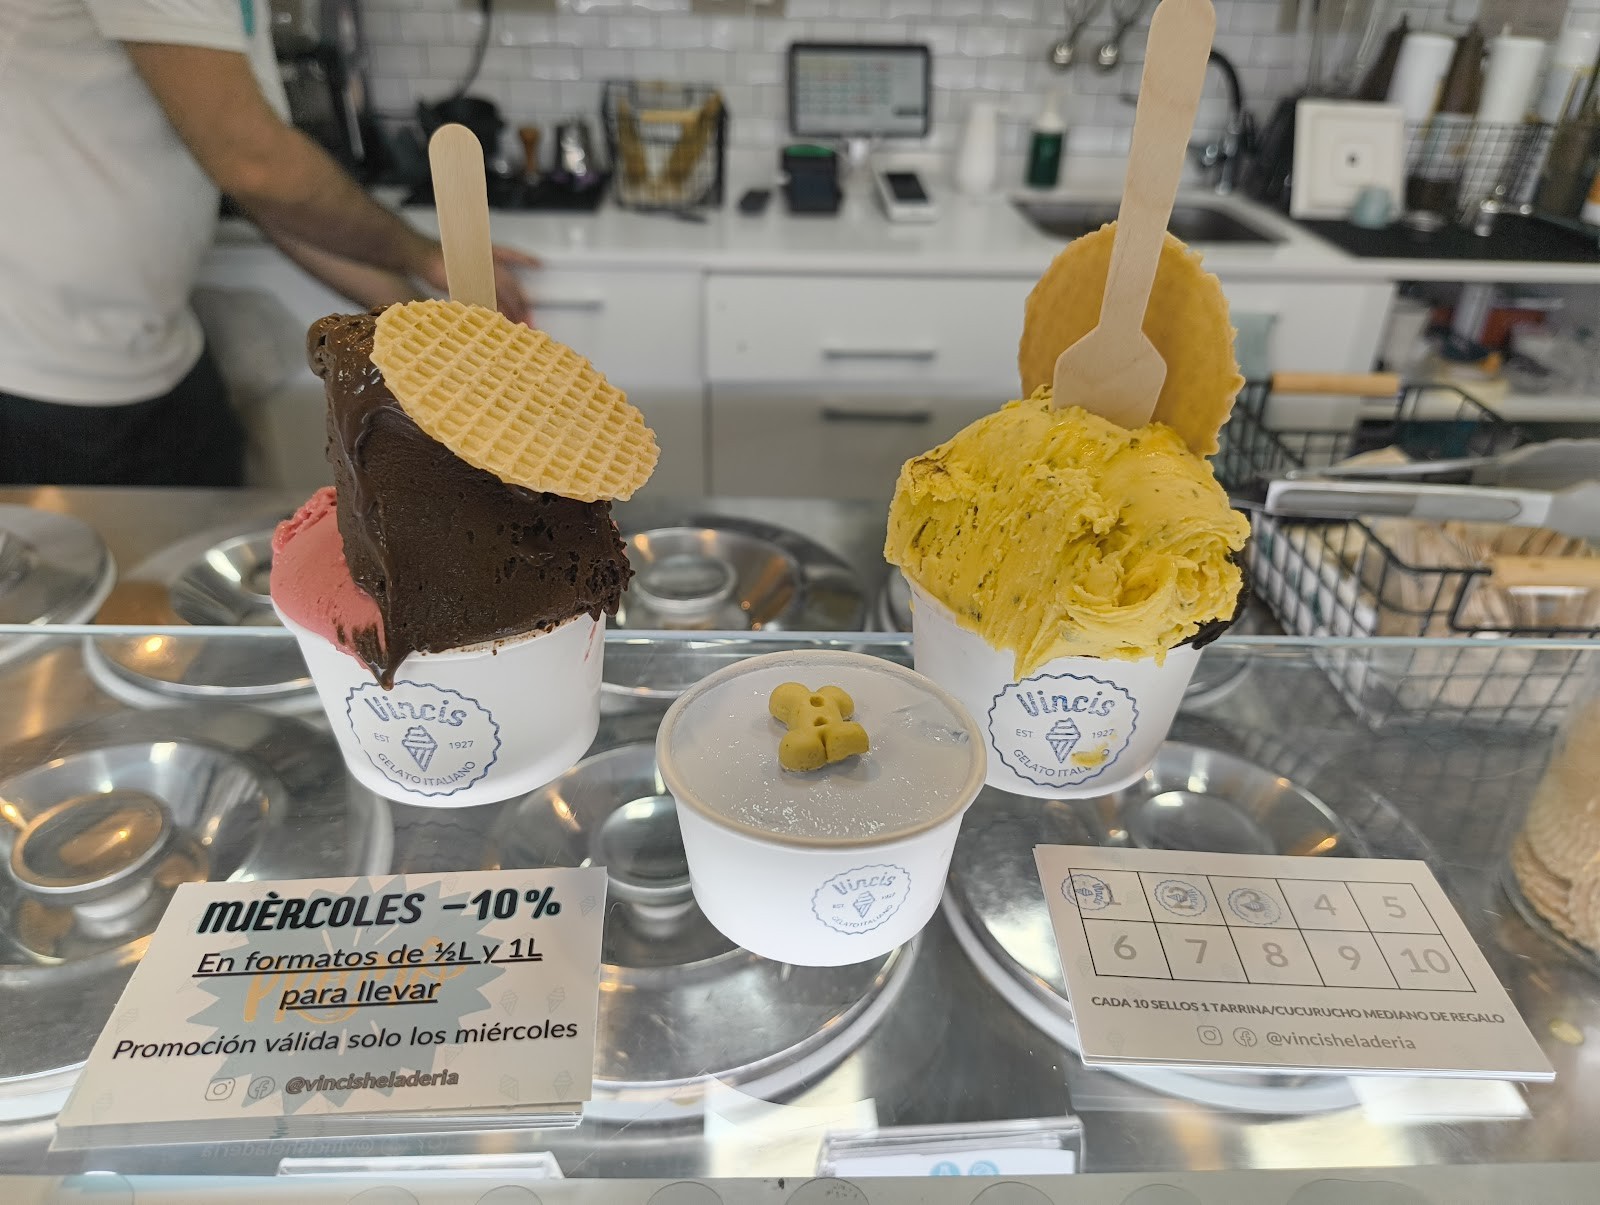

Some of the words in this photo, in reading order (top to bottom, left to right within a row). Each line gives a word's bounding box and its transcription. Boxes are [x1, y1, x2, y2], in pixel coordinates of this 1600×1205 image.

[364, 696, 467, 726] Vincis
[1017, 690, 1115, 717] Vincis
[374, 732, 390, 743] EST
[449, 740, 474, 750] 1927
[1016, 728, 1034, 738] EST
[1092, 728, 1114, 739] 1927
[378, 753, 421, 784] GELATO
[424, 761, 476, 786] ITALIANO
[1013, 749, 1055, 777] GELATO
[832, 872, 896, 895] Vincis
[197, 891, 426, 934] MIÈRCOLES
[1168, 887, 1194, 910] 2
[1313, 893, 1337, 916] 4
[1382, 895, 1407, 919] 5
[196, 952, 235, 974] En
[244, 949, 378, 972] formatos
[387, 944, 425, 964] de
[482, 944, 500, 964] y
[509, 938, 543, 959] 1L
[1113, 935, 1137, 960] 6
[1184, 938, 1208, 964] 7
[1262, 942, 1289, 967] 8
[1338, 945, 1361, 970] 9
[1400, 947, 1451, 974] 10
[279, 987, 347, 1011] para
[357, 980, 442, 1002] llevar
[1091, 996, 1131, 1009] CADA
[1133, 998, 1149, 1009] 10
[1151, 999, 1199, 1012] SELLOS
[1201, 1002, 1210, 1012] 1
[1212, 1002, 1362, 1019] TARRINA/CUCURUCHO
[1363, 1008, 1429, 1021] MEDIANO
[1430, 1011, 1450, 1022] DE
[1450, 1012, 1506, 1024] REGALO
[112, 1034, 257, 1060] Promoción
[265, 1030, 340, 1053] válida
[347, 1027, 402, 1049] solo
[410, 1026, 446, 1046] los
[455, 1019, 578, 1044] miércoles
[1266, 1031, 1417, 1050] @vincisheladeria
[285, 1068, 460, 1095] @vincisheladeria
